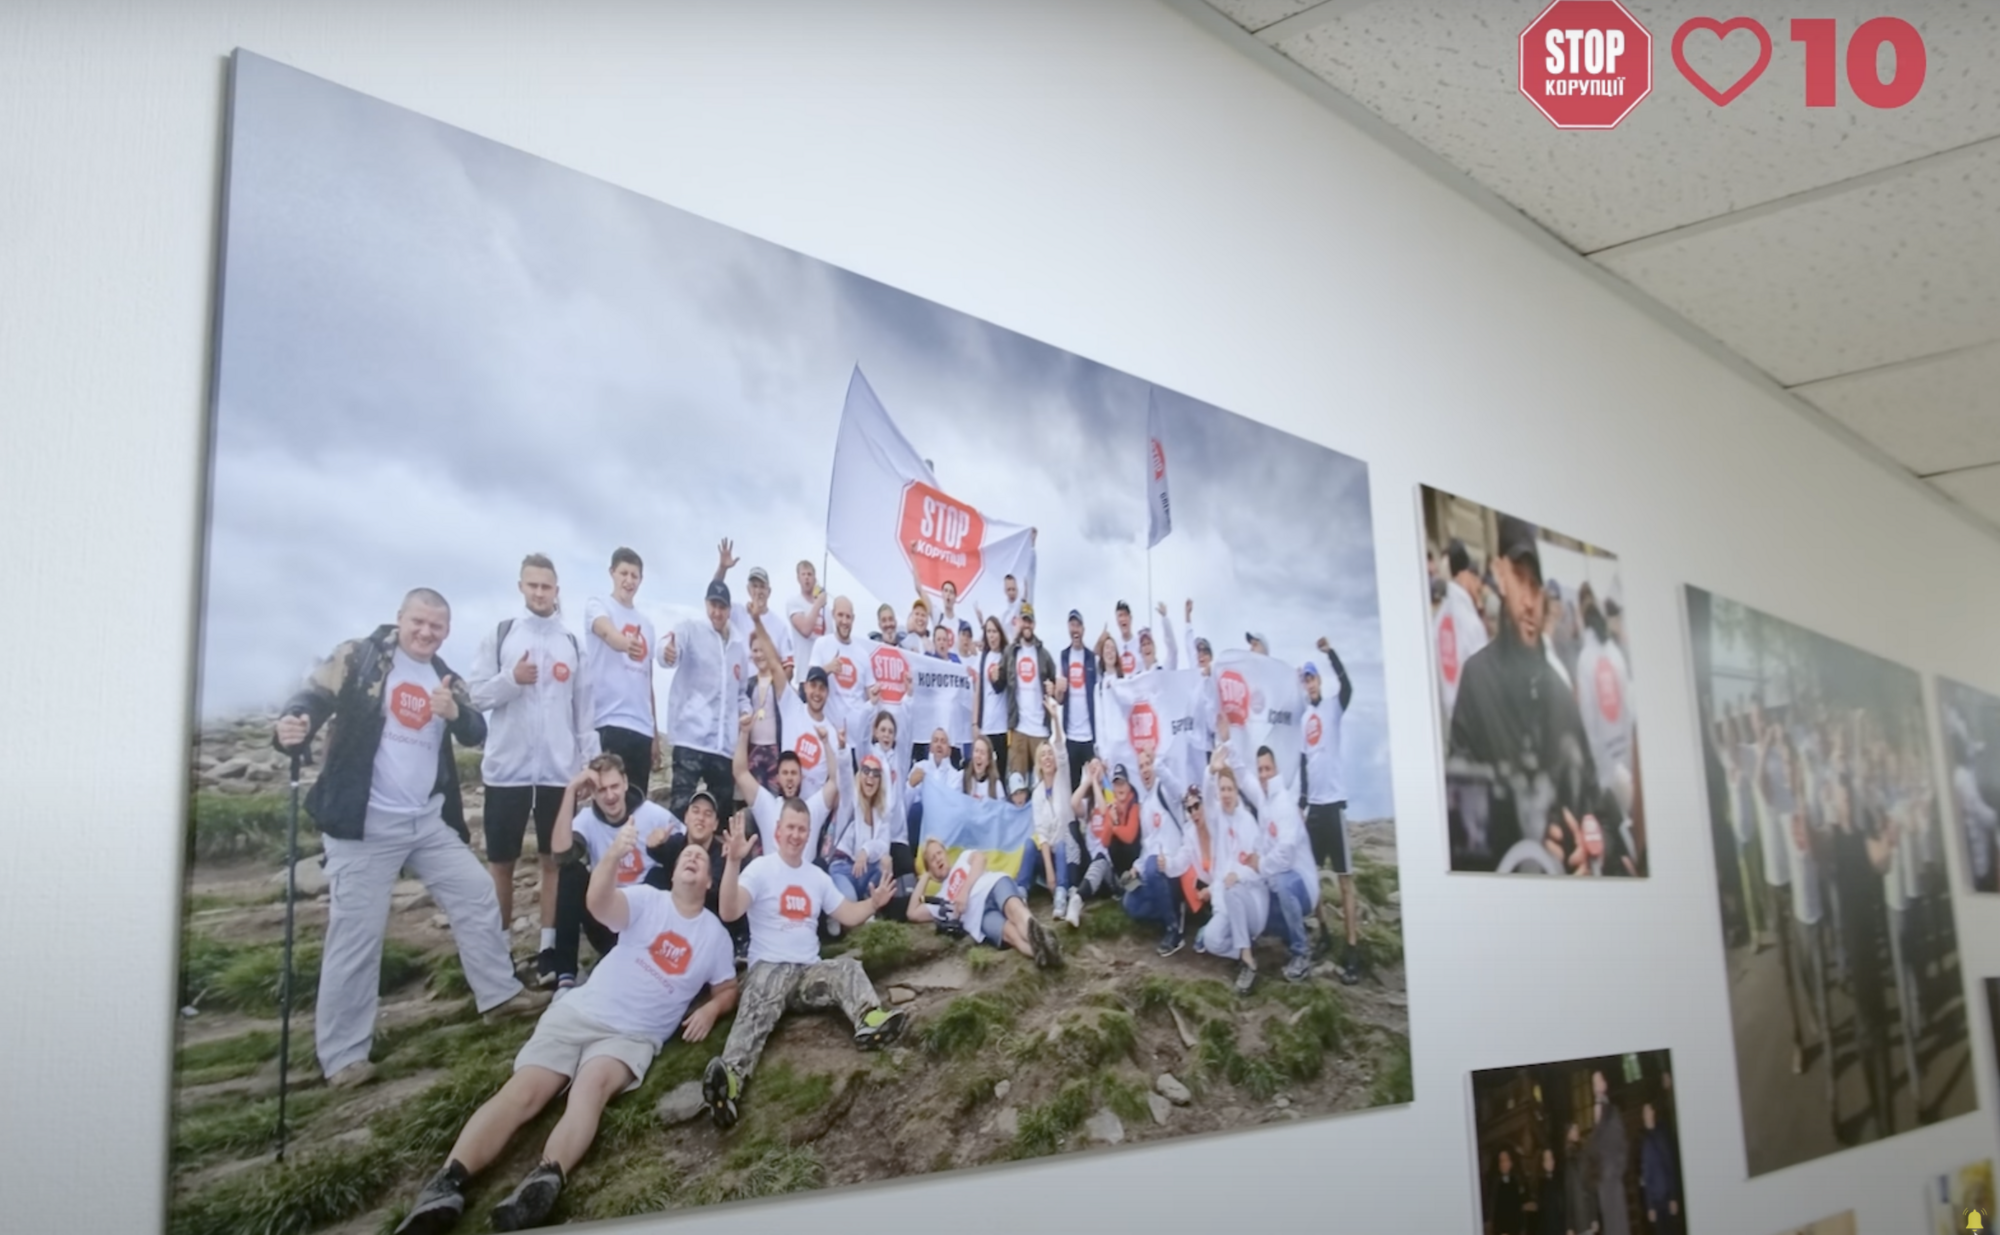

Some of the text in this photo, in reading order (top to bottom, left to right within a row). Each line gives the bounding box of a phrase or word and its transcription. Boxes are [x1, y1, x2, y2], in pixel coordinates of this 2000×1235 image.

[920, 495, 970, 550] STOP
[874, 654, 904, 681] STOP
[917, 672, 971, 690] КОРОСТЕНЬ
[400, 691, 426, 713] STOP
[785, 895, 807, 912] STOP
[660, 939, 688, 963] STOP
